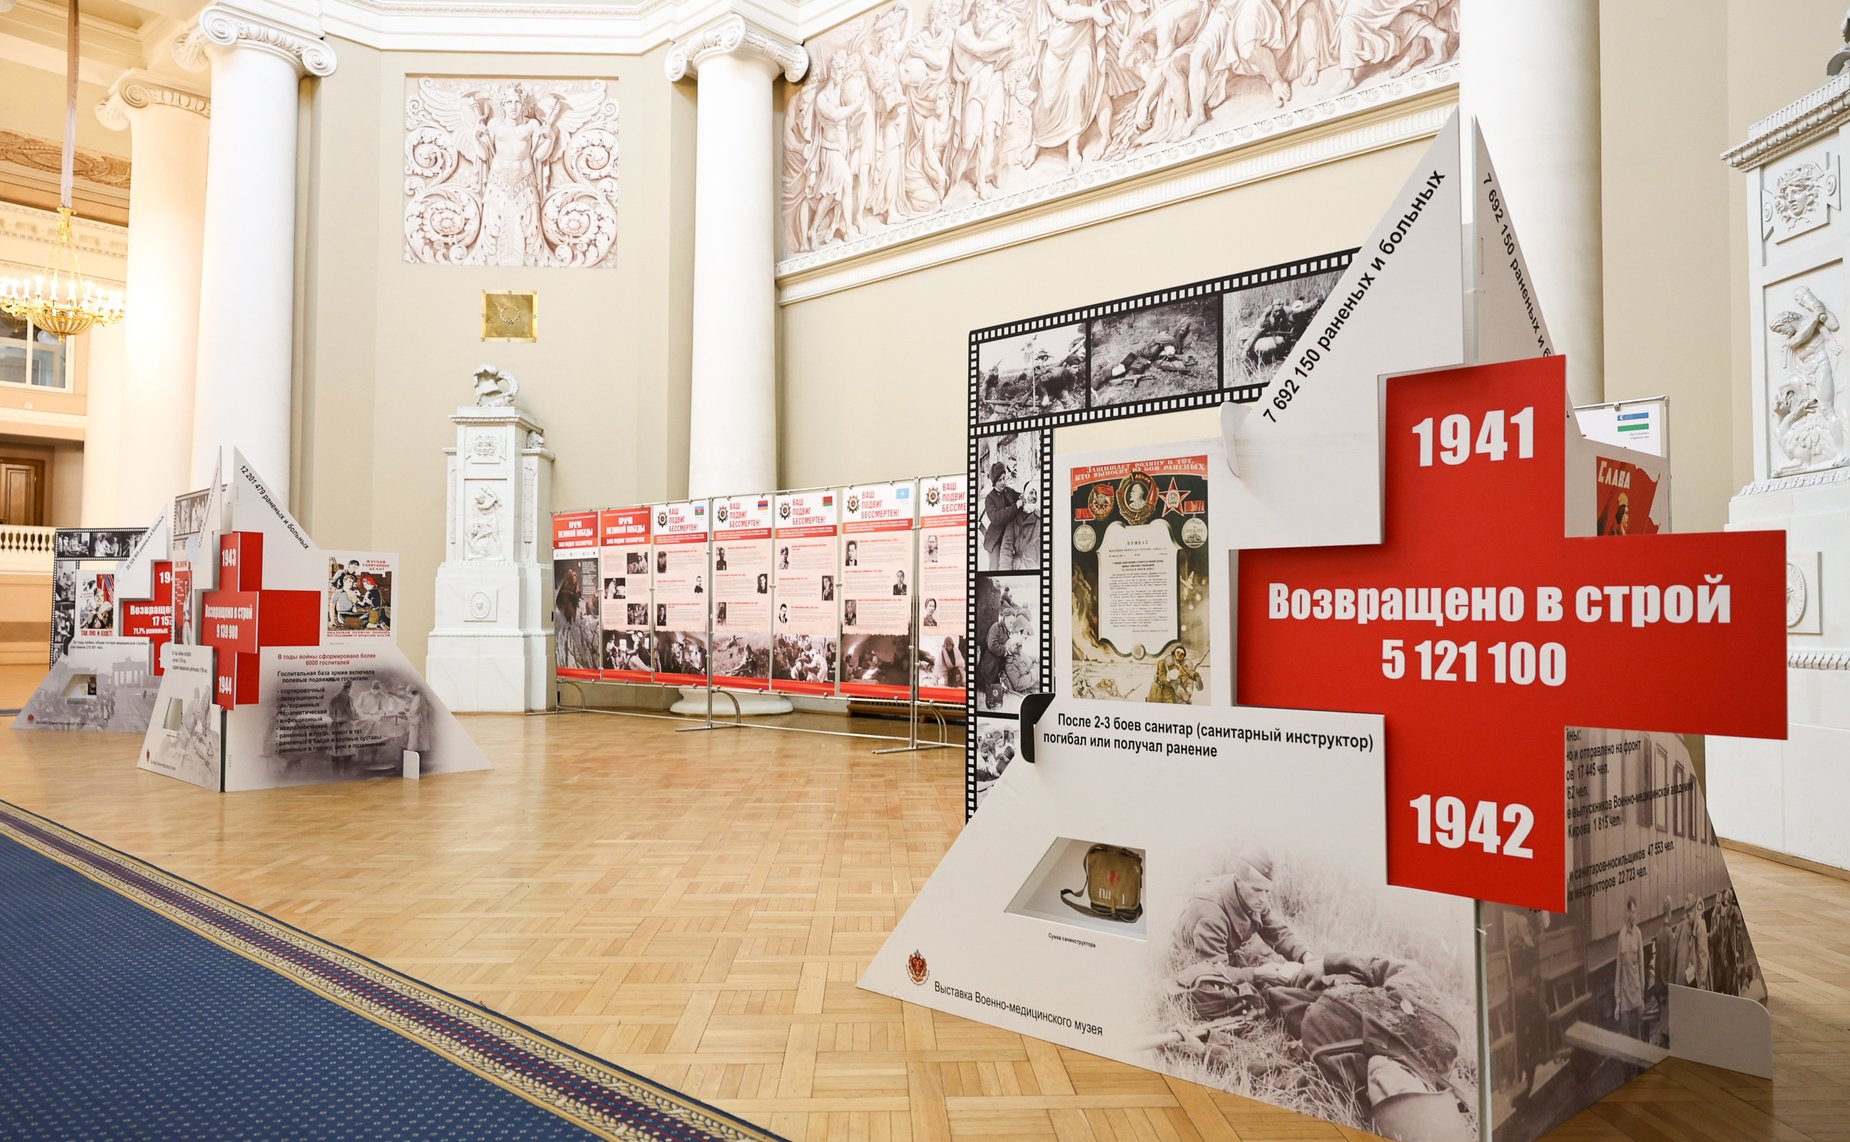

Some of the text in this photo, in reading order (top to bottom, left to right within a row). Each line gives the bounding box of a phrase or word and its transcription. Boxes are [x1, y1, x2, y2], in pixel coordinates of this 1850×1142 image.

[1483, 172, 1493, 185] 7
[1488, 189, 1504, 223] 692
[1500, 224, 1515, 256] 150
[1510, 258, 1540, 335] раненых
[1537, 334, 1545, 349] и
[1263, 170, 1446, 423] 7 692 150 раненых и больных
[1412, 406, 1534, 466] 1941
[1074, 473, 1091, 481] КТО
[1093, 469, 1129, 478] ВЫНОСИТ
[861, 491, 875, 499] ВАШ
[942, 483, 957, 492] ВАШ
[240, 465, 250, 475] 12
[262, 494, 285, 521] раненых
[287, 523, 309, 550] больных
[729, 502, 741, 510] ВАШ
[792, 498, 805, 507] ВАШ
[792, 507, 811, 516] ПОДВИГ
[861, 500, 883, 509] ПОДВИГ
[669, 515, 685, 524] ПОДВИГ
[729, 510, 748, 519] ПОДВИГ
[222, 548, 237, 567] 1943
[159, 571, 172, 584] 19
[1268, 574, 1731, 628] Возвращено в строй
[319, 652, 359, 660] сформировано
[1382, 639, 1567, 687] 5 121 100
[277, 670, 316, 678] Госпитальная
[218, 675, 232, 695] 1944
[1058, 712, 1375, 753] После 2-3 боев санитар (санитарный инструктор)
[1043, 732, 1218, 758] погибал или получал ранение
[1580, 744, 1615, 761] отправлено
[1615, 742, 1623, 754] на
[1623, 738, 1641, 756] фронт
[1577, 764, 1584, 779] 17
[1585, 762, 1597, 777] 445
[1597, 763, 1610, 776] чел.
[1572, 799, 1613, 819] выпускников
[1409, 794, 1535, 860] 1942
[1574, 849, 1646, 881] санитаров-носильщиков
[1647, 843, 1655, 857] 47
[1655, 840, 1664, 856] 553
[1664, 840, 1675, 852] чел.
[1574, 866, 1648, 900] инструкторов 22 723 чел.
[934, 980, 1103, 1036] Выставка Военно-медицинского музея
